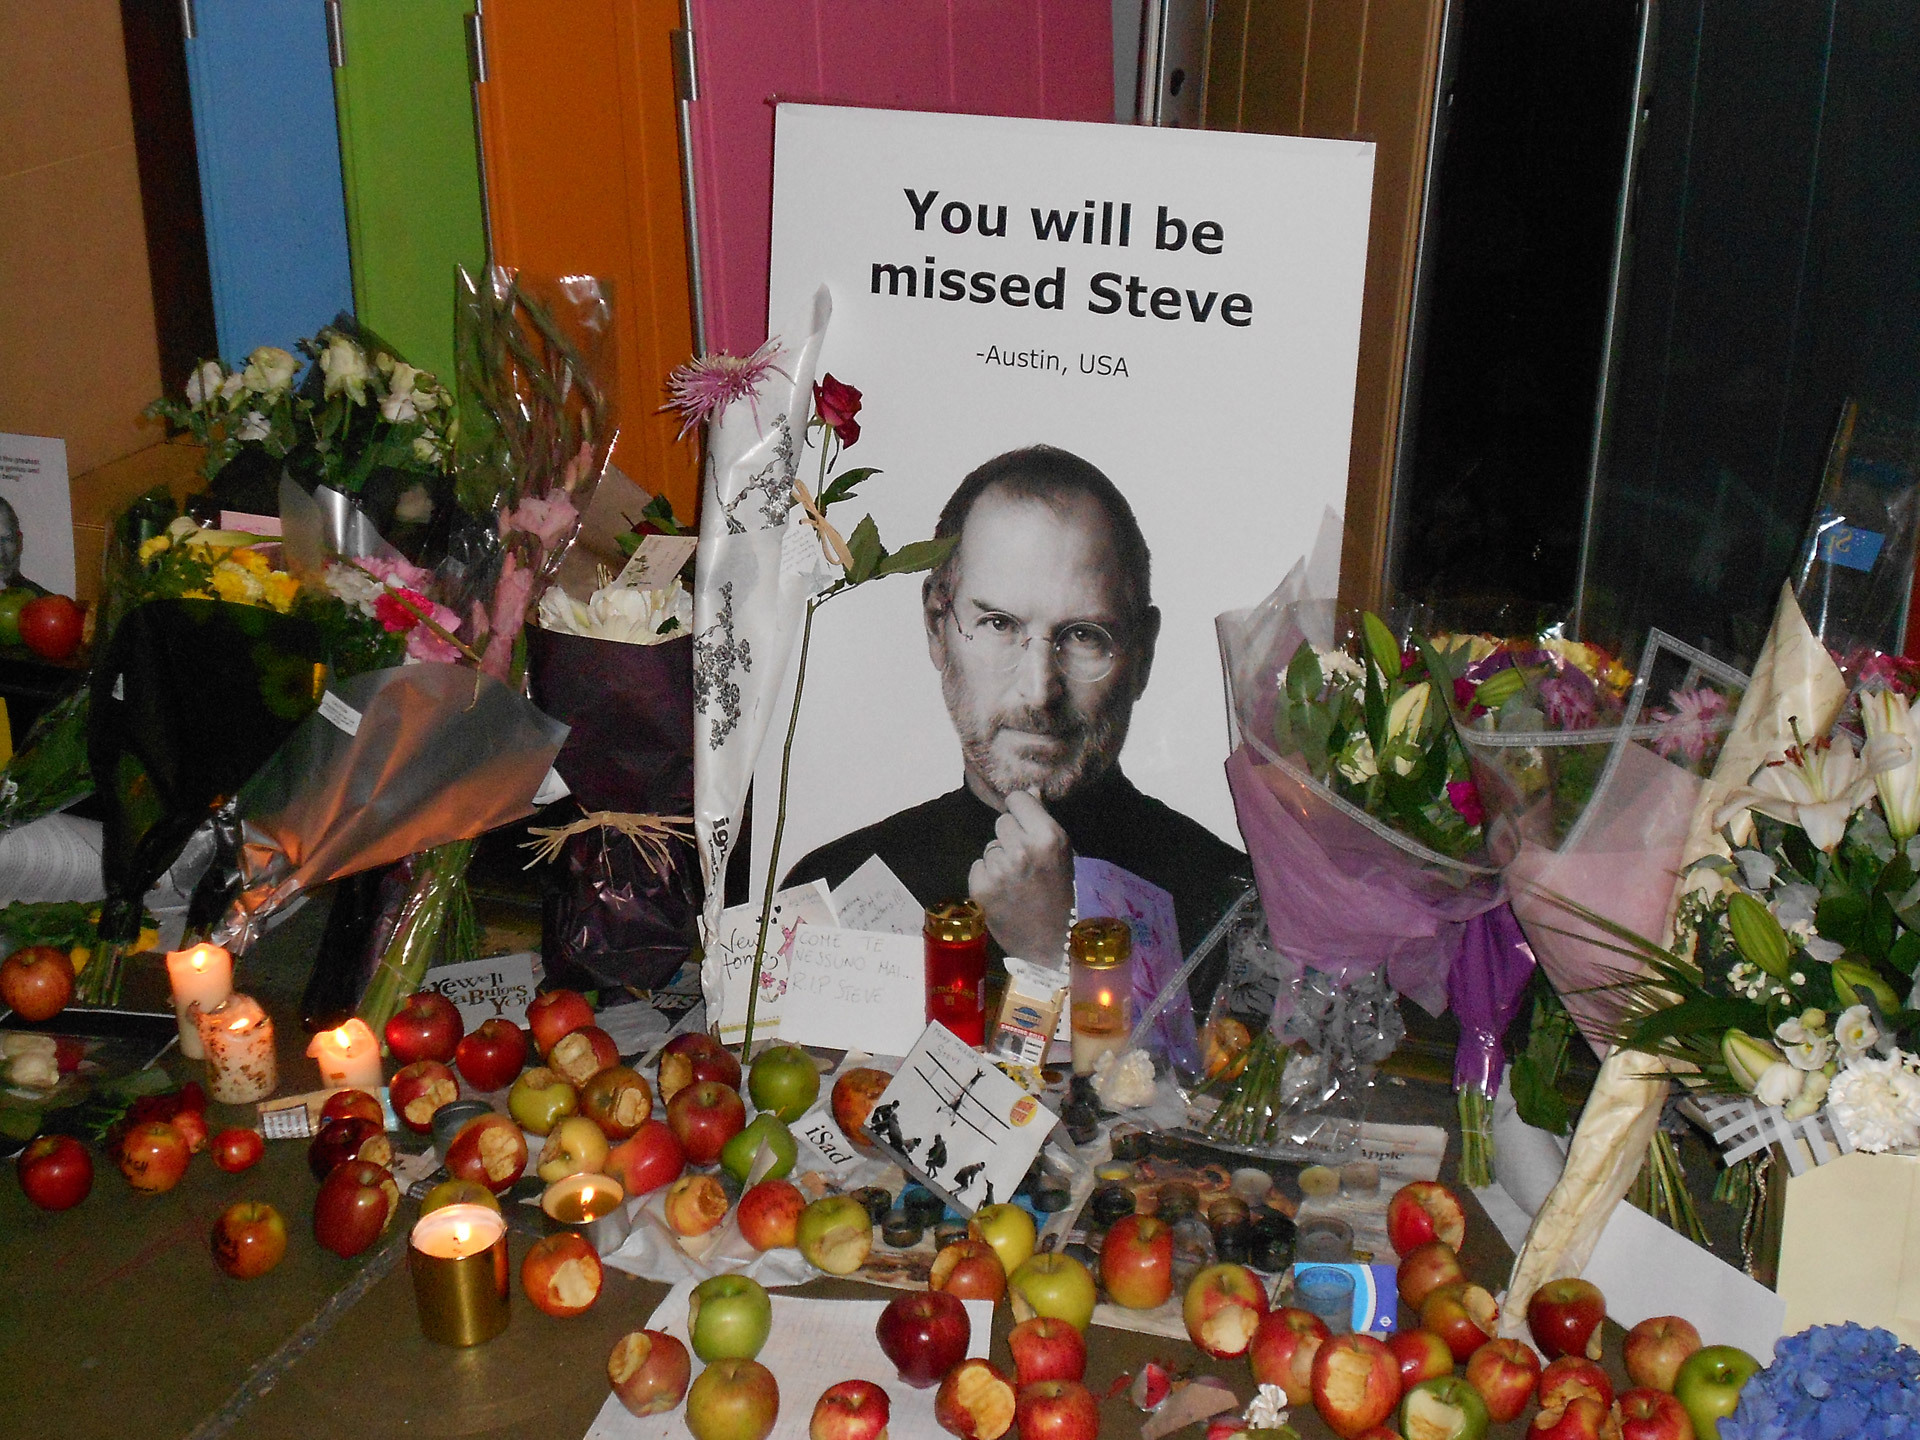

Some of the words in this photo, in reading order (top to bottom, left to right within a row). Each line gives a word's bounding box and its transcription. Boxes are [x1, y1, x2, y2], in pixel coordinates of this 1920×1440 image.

[904, 188, 1008, 238] You
[1030, 199, 1132, 248] will
[1155, 205, 1225, 255] be
[870, 255, 1066, 311] missed
[1088, 271, 1254, 328] Steve
[976, 345, 1068, 376] -Austin,
[1079, 353, 1130, 378] USA
[859, 936, 885, 953] TE
[804, 1124, 854, 1165] iSad
